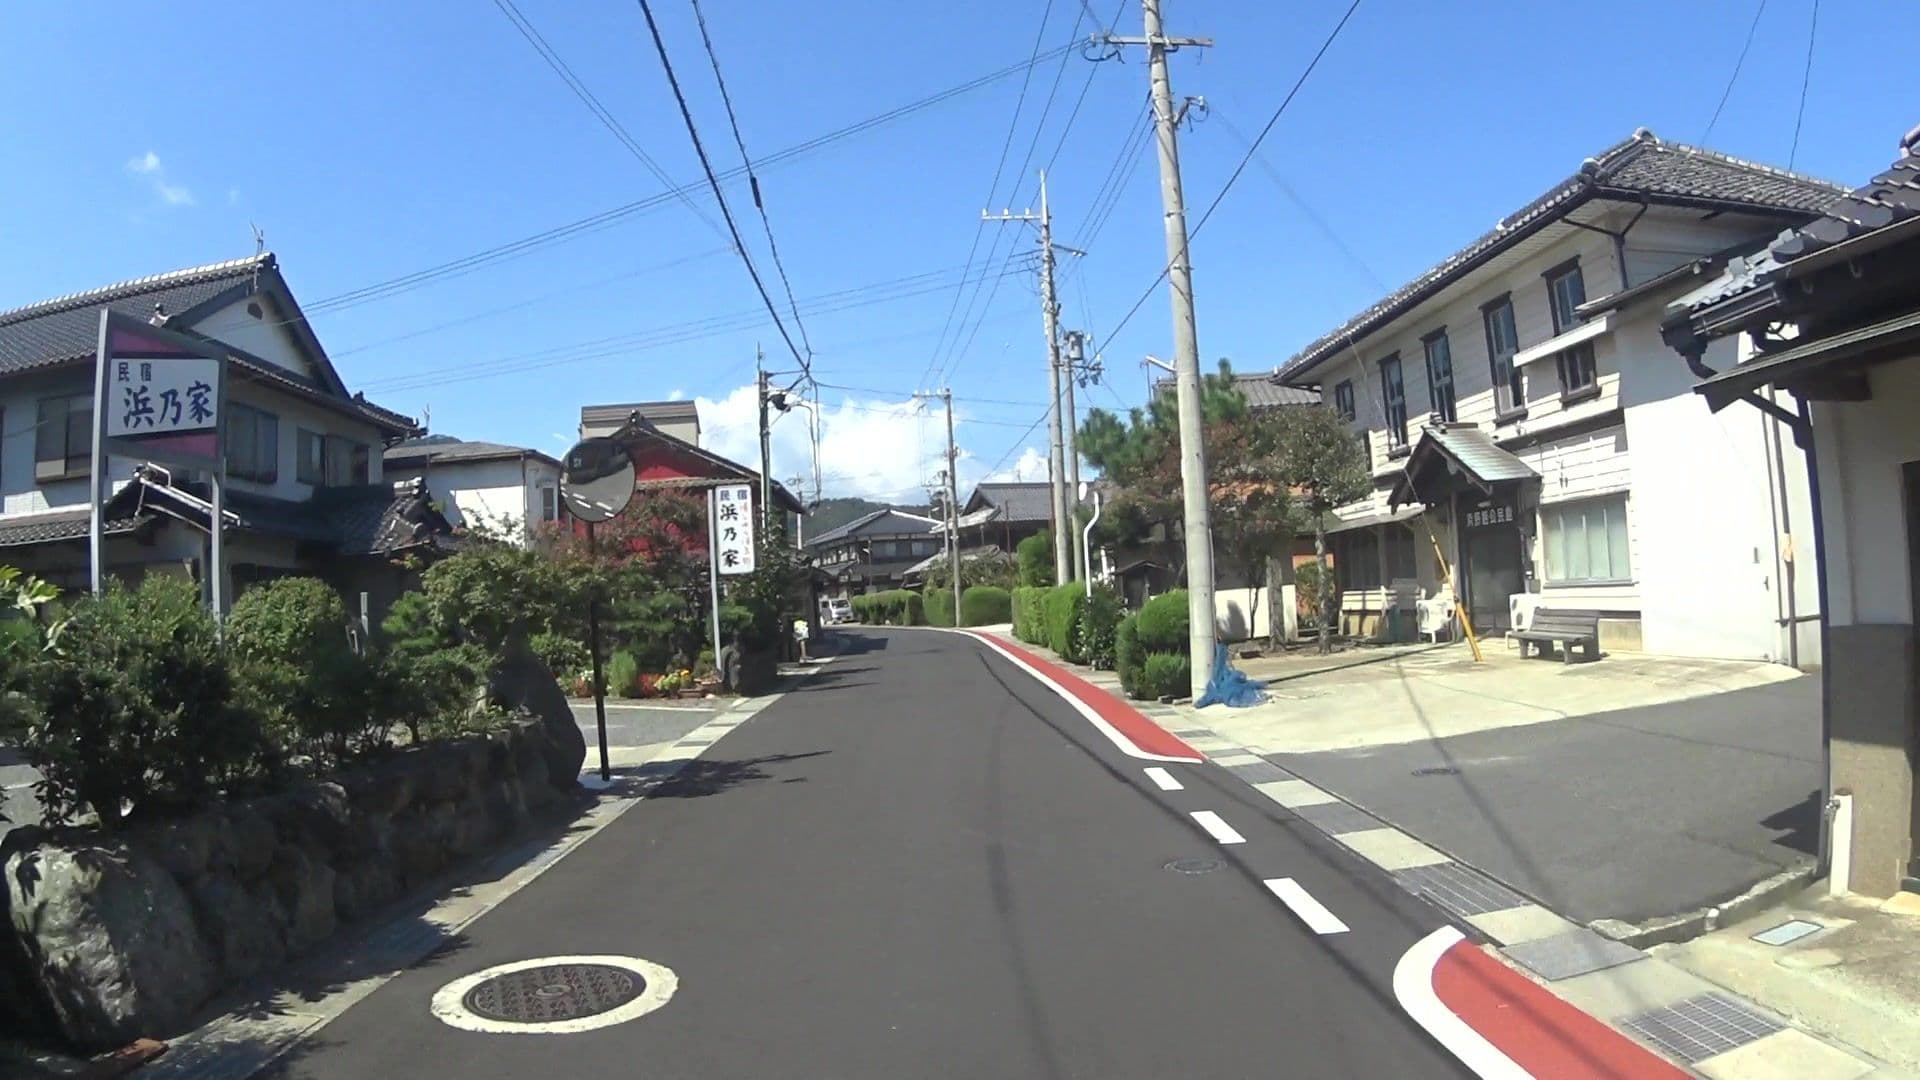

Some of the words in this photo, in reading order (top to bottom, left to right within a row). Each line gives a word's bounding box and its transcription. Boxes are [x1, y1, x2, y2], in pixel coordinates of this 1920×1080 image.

[118, 361, 152, 382] 民宿
[123, 380, 214, 429] 浜乃家
[720, 489, 748, 501] 民宿
[720, 503, 739, 567] 浜乃家
